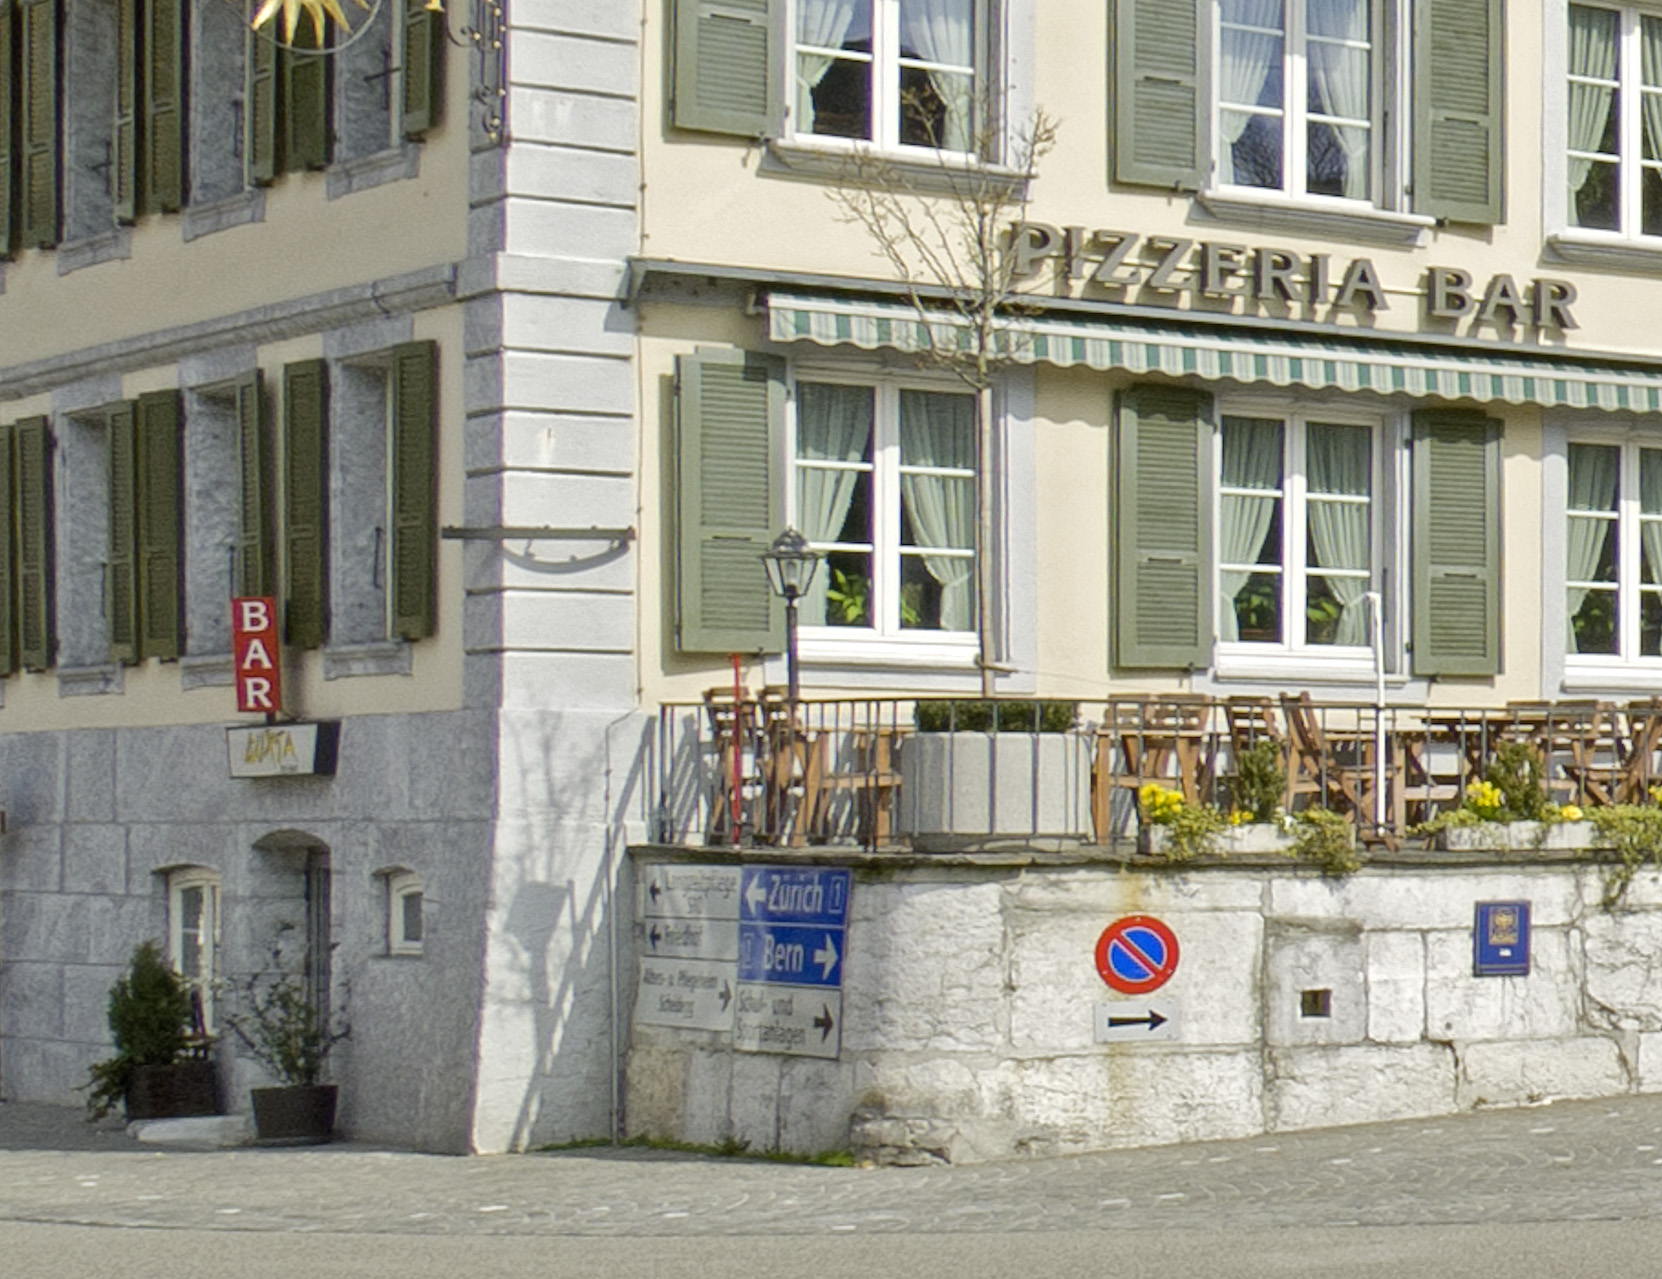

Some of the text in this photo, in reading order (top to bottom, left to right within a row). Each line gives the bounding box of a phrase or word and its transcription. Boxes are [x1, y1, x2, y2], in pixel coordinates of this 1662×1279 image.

[1009, 220, 1579, 329] PIZZERIA BAR
[241, 600, 273, 708] BAR
[767, 874, 824, 913] Zürich
[764, 933, 804, 973] Bern
